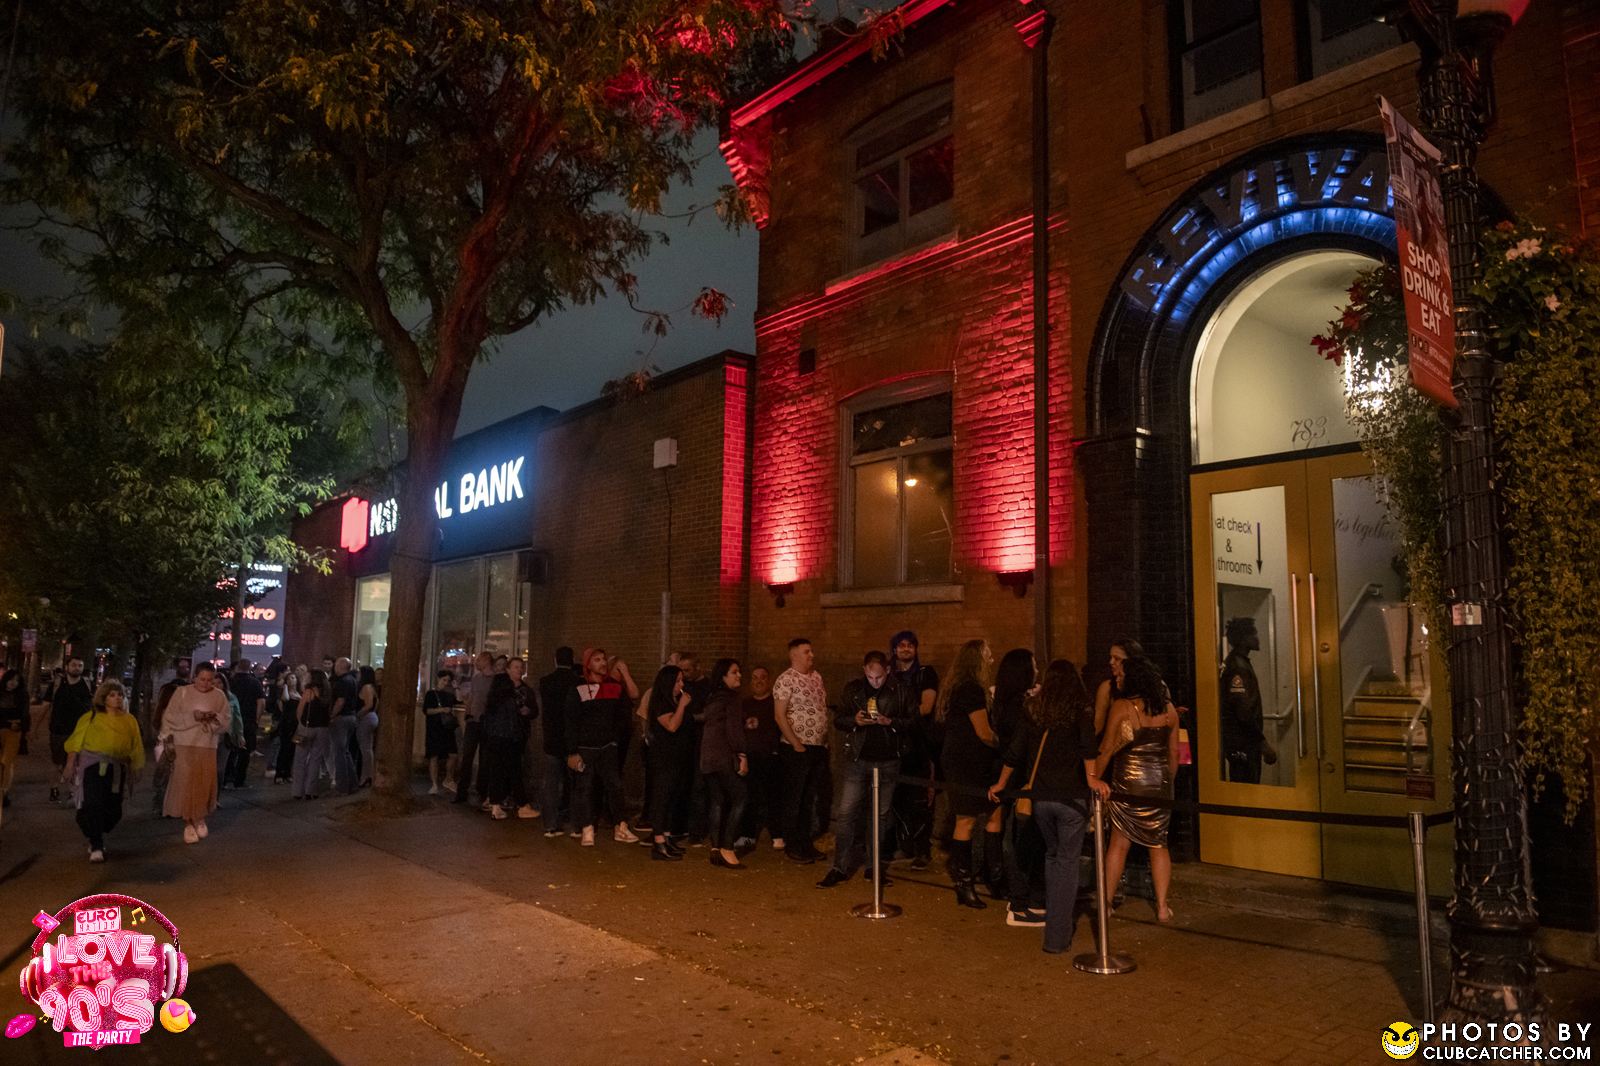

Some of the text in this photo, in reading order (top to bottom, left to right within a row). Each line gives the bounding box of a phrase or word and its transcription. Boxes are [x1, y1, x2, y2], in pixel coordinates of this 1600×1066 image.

[1120, 149, 1391, 307] REVIVA
[1404, 266, 1450, 317] DRINK &
[1421, 303, 1441, 336] EAT
[459, 455, 525, 514] BANK
[1215, 516, 1252, 534] at check
[1225, 538, 1232, 553] &
[1216, 557, 1253, 575] throoms
